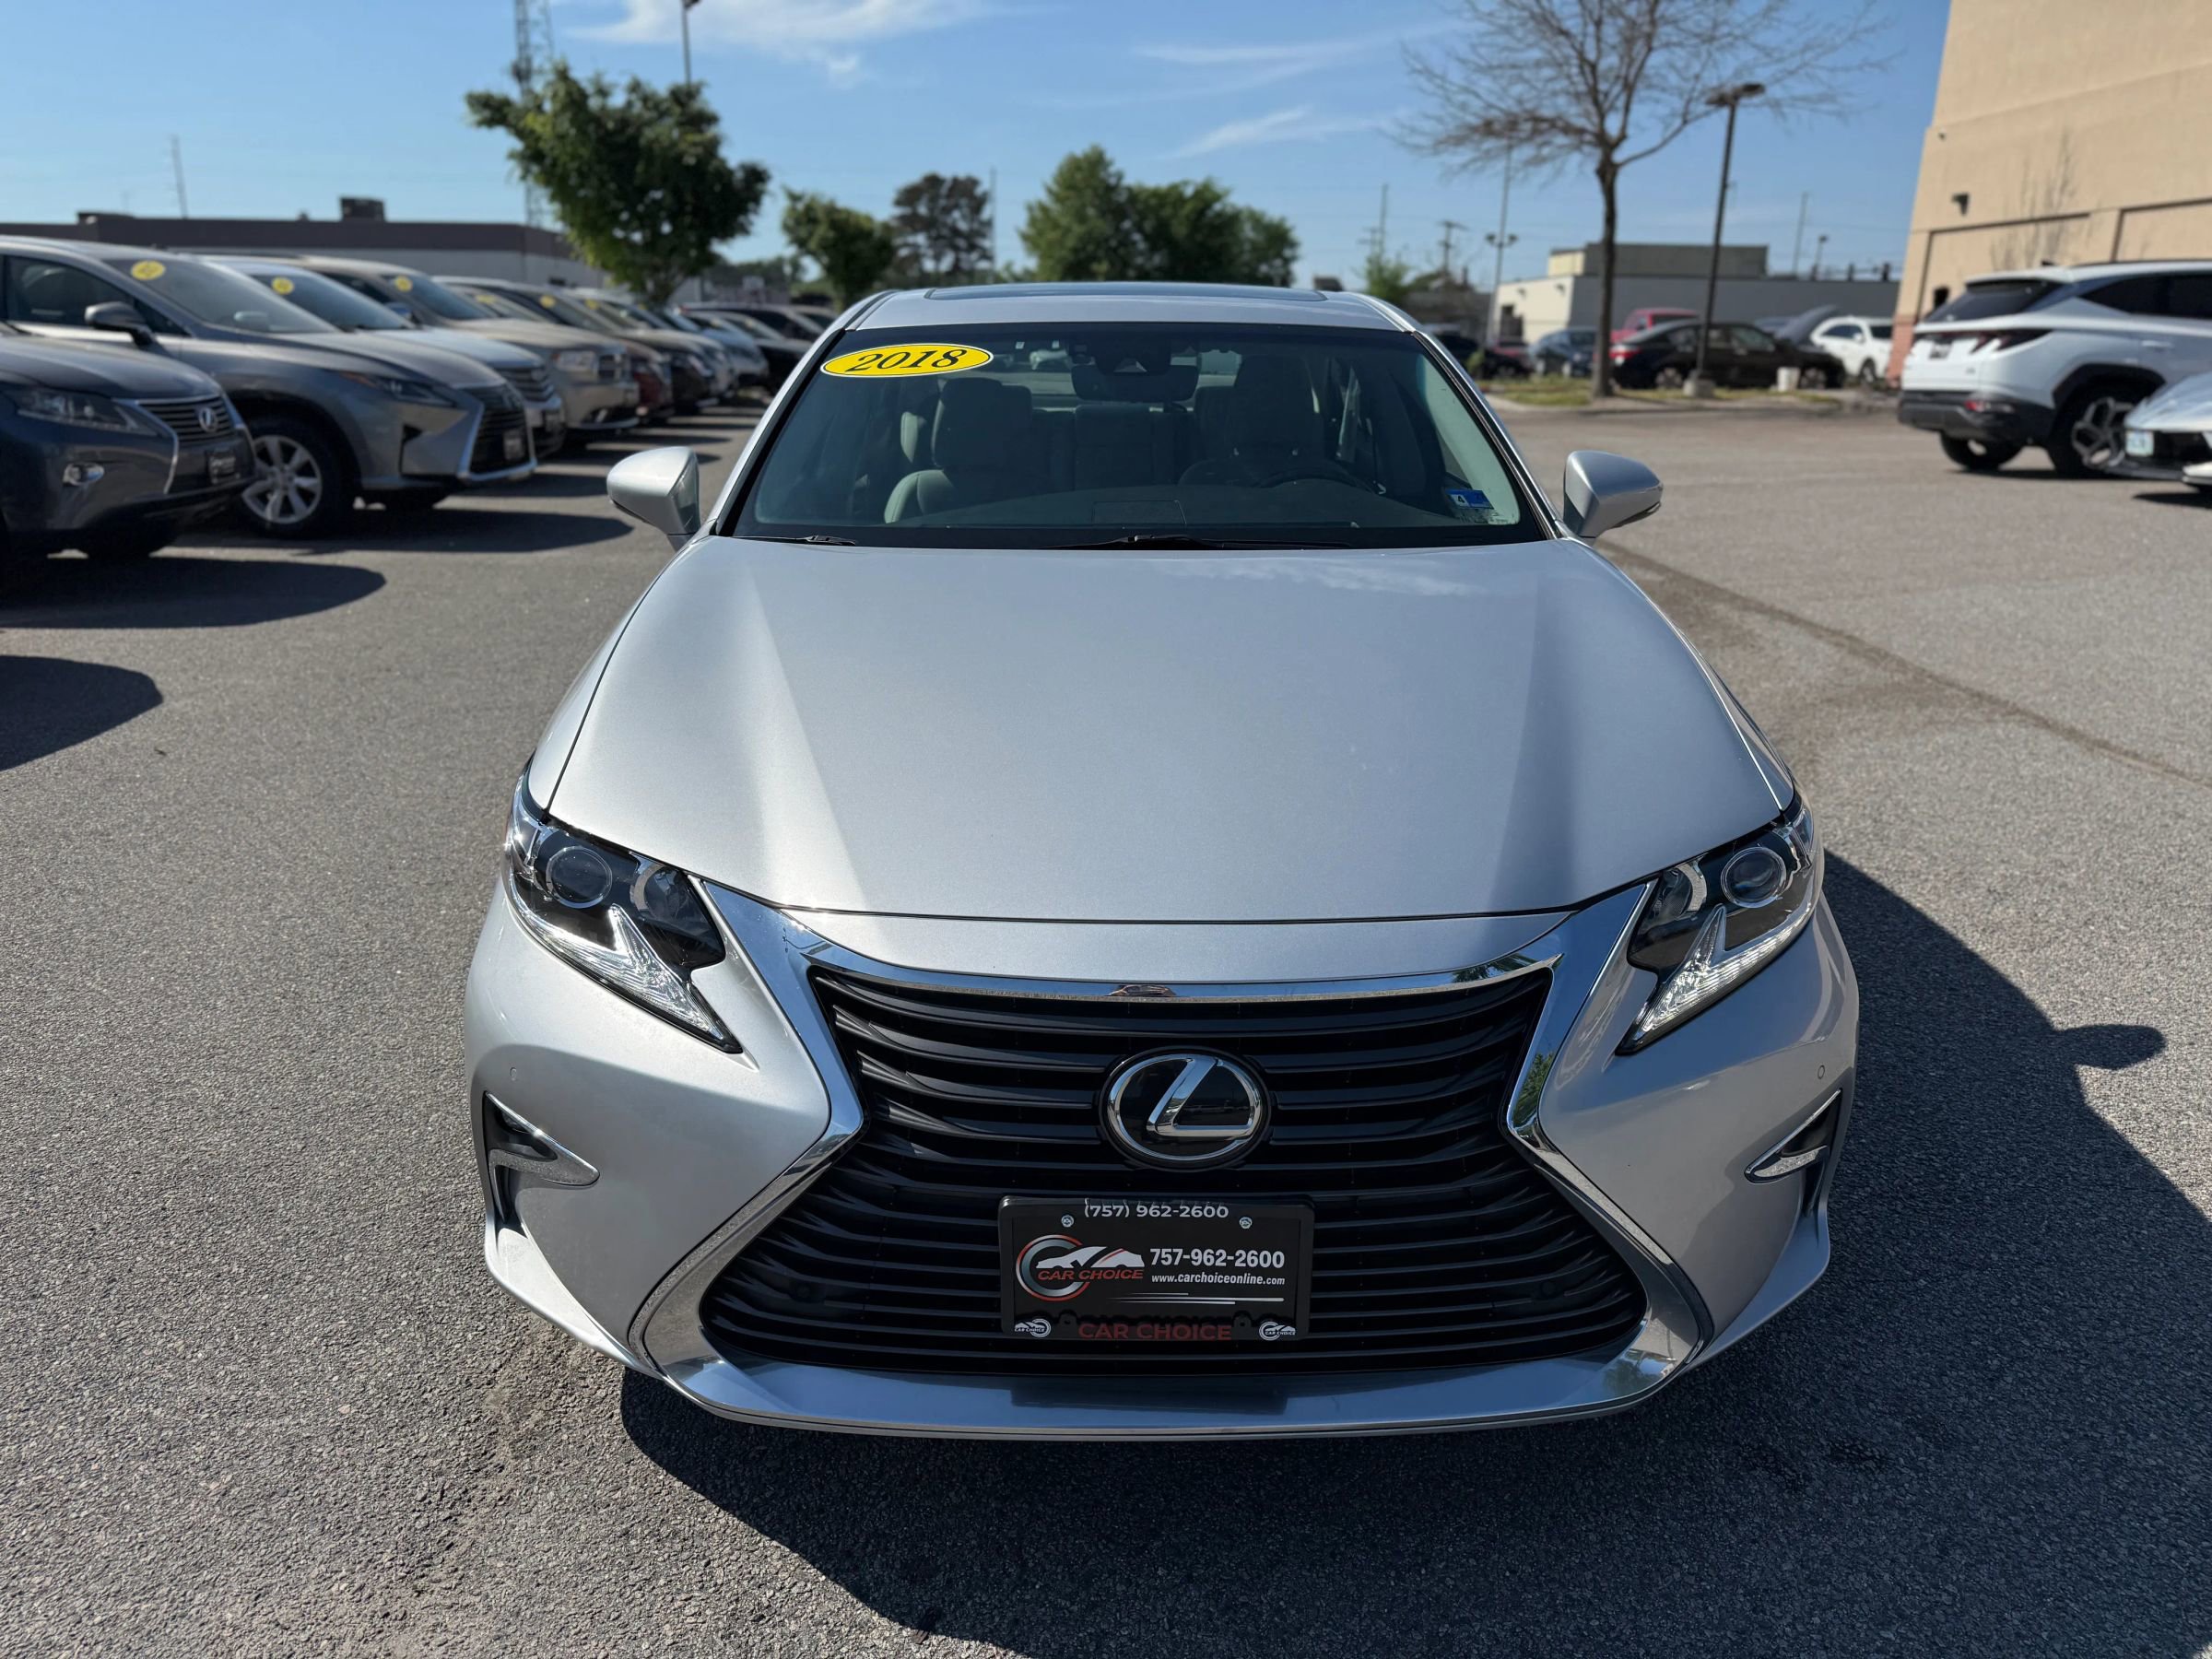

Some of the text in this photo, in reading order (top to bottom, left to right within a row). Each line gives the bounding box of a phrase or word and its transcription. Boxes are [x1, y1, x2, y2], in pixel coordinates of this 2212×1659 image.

[845, 349, 967, 372] 2018
[1084, 1204, 1230, 1218] (757) 962-2600
[1149, 1248, 1285, 1268] 757-962-2600
[1037, 1269, 1144, 1280] CAR CHOICE
[1151, 1272, 1286, 1286] www.carchoiceonline.com
[1077, 1323, 1232, 1341] CAR CHOICE
